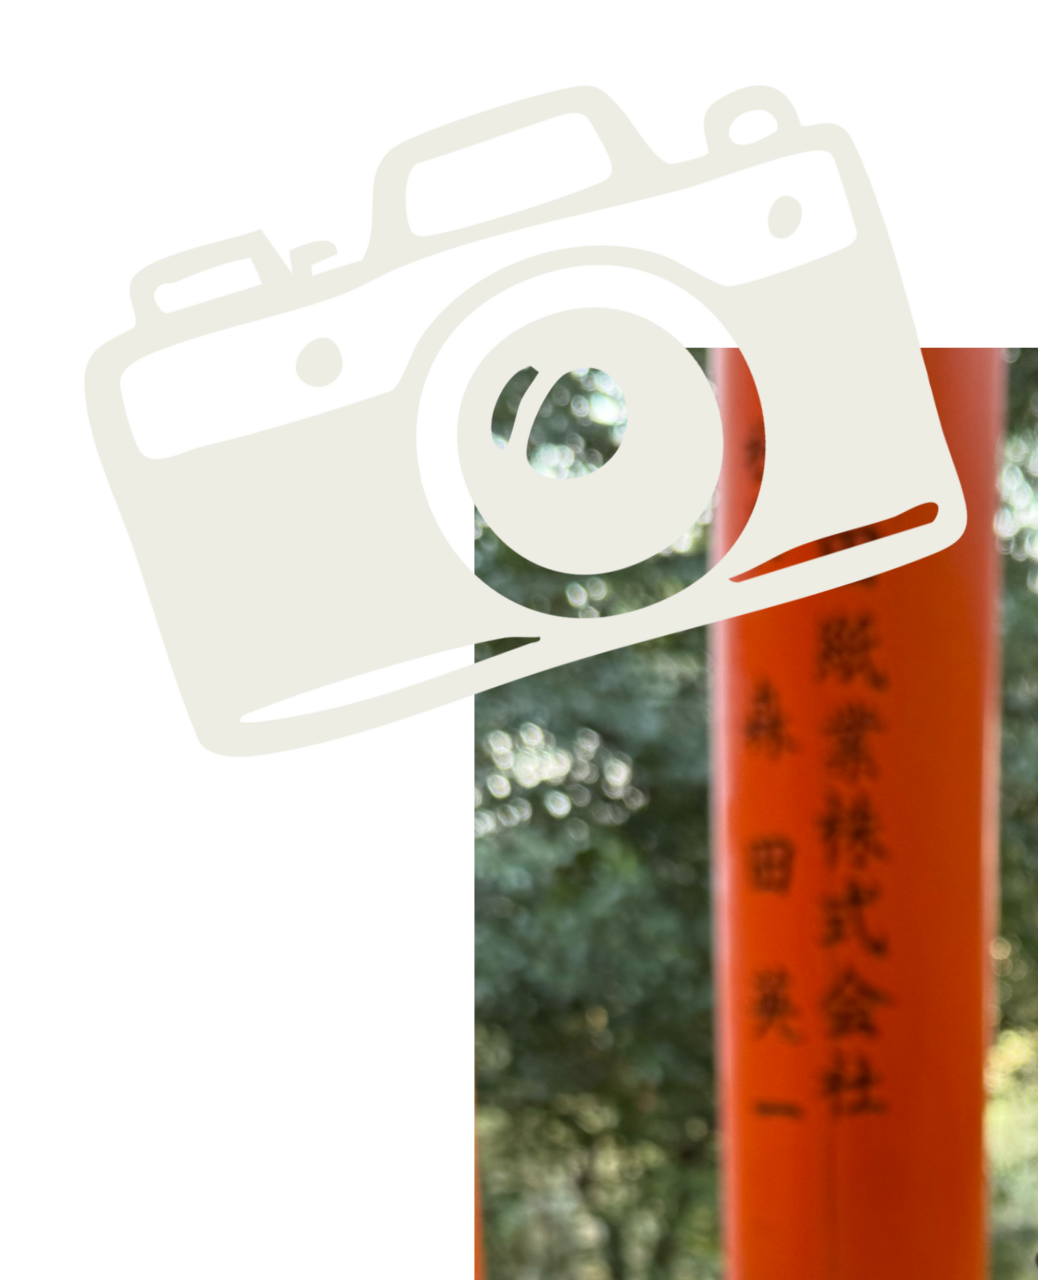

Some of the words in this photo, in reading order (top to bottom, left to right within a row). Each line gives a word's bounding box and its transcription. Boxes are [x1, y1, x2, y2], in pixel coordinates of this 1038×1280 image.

[815, 528, 893, 1117] 紙業株式会社
